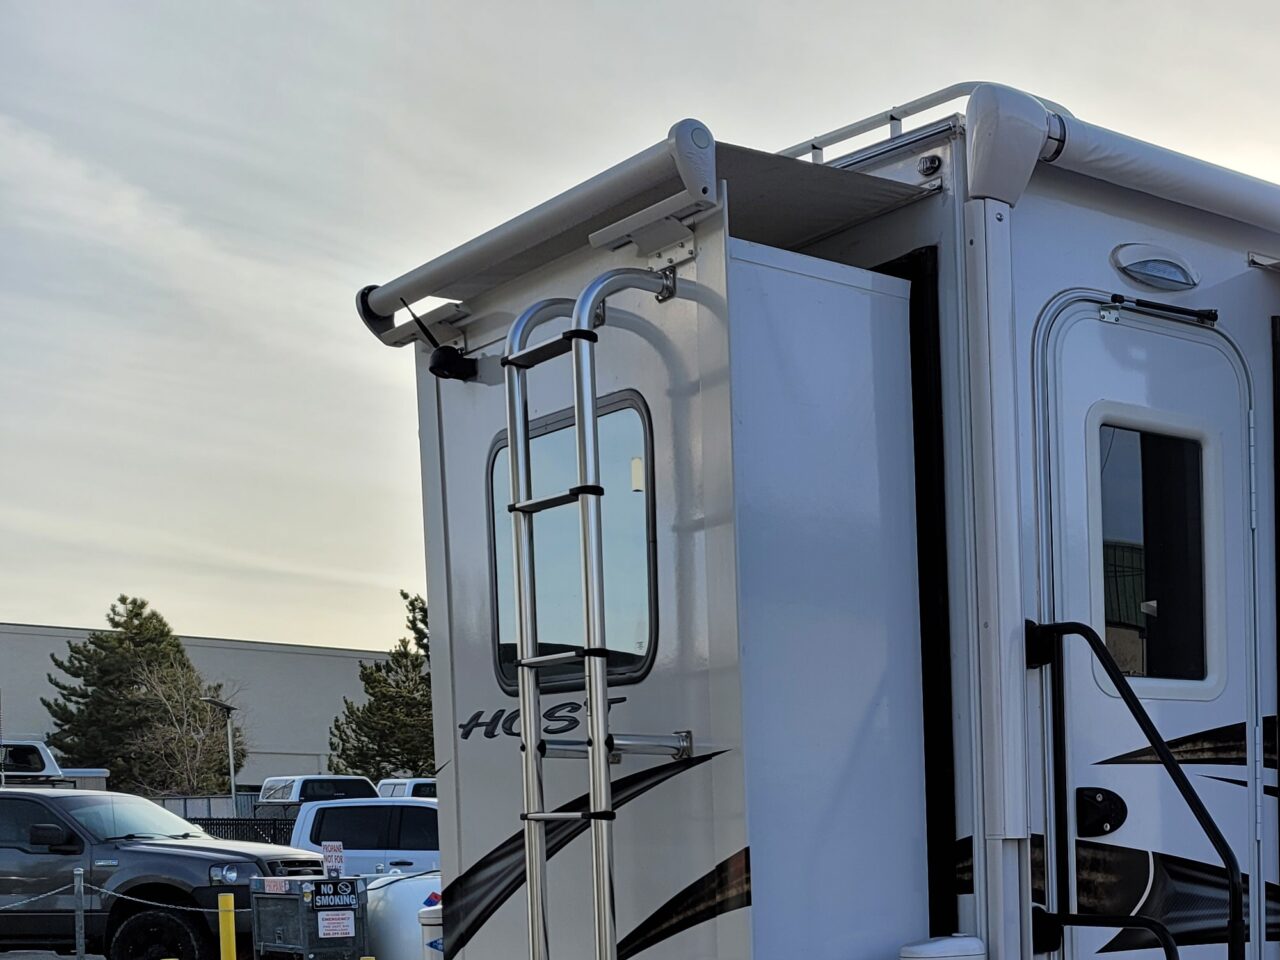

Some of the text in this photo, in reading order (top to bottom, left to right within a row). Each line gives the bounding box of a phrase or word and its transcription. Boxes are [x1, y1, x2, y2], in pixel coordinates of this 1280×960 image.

[458, 697, 627, 740] HOS
[320, 884, 334, 895] NO
[315, 894, 356, 906] SMOKING
